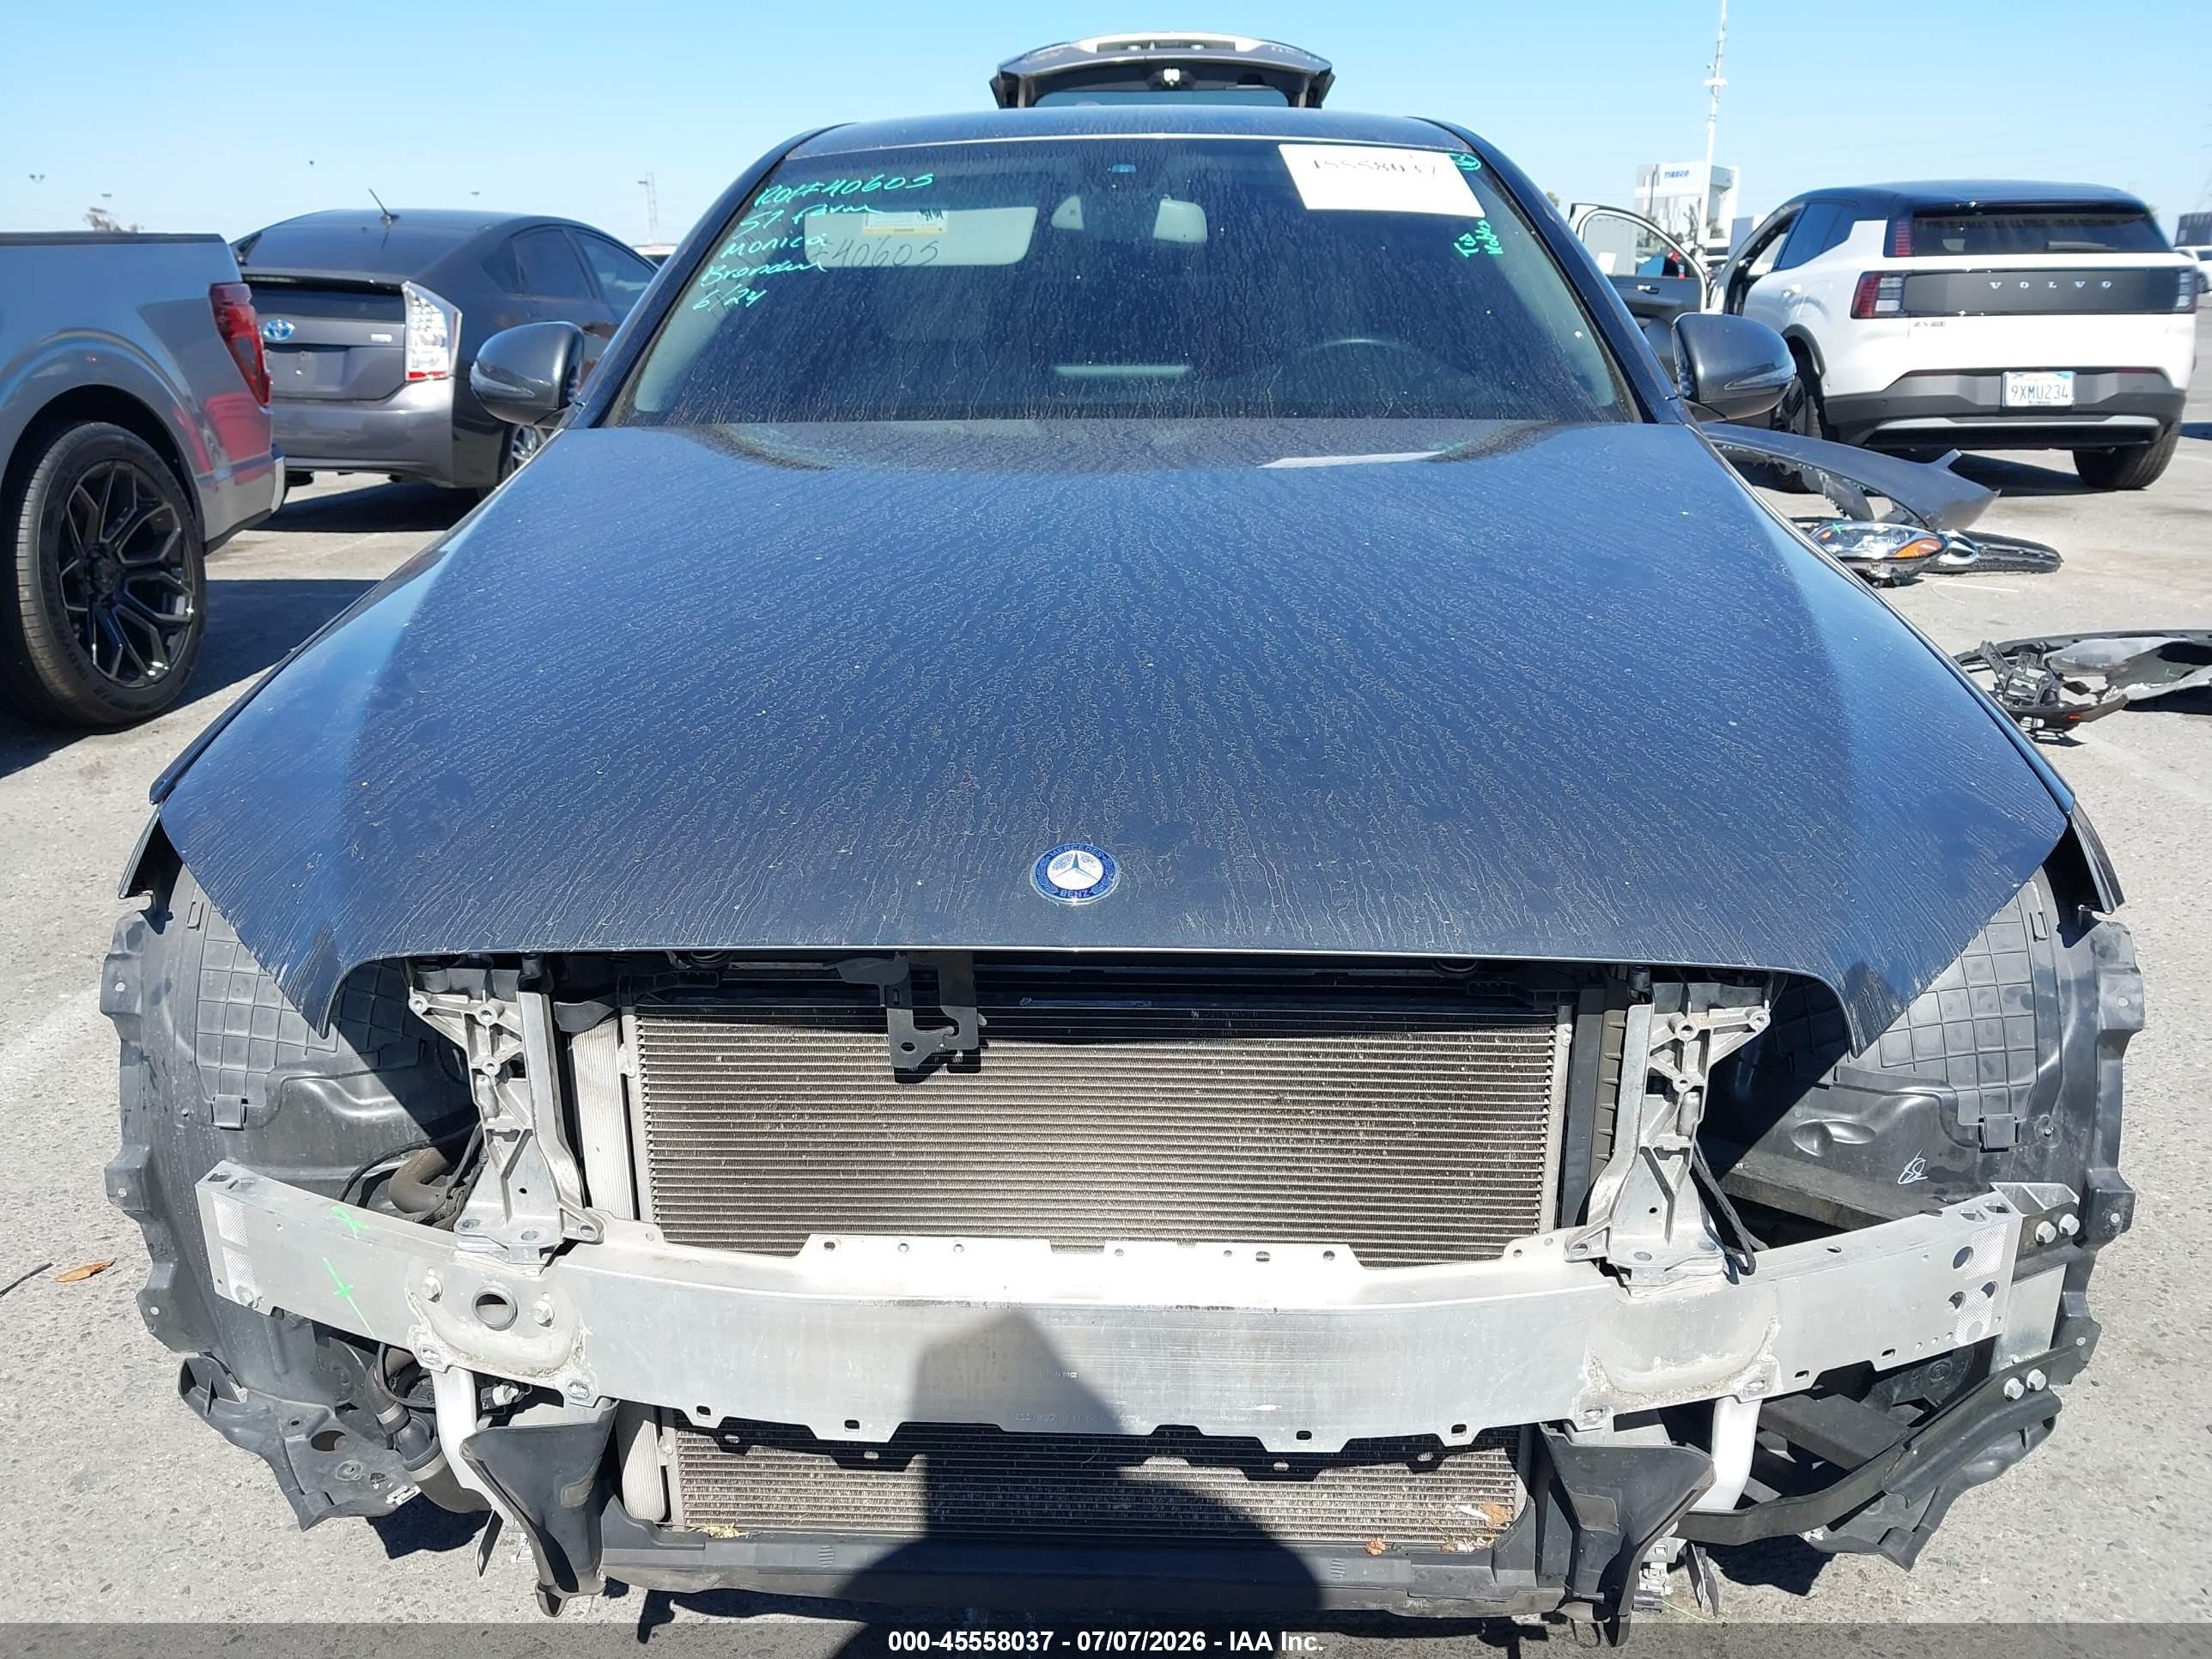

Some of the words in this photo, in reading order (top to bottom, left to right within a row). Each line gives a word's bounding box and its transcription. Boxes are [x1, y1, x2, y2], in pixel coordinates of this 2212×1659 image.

[1989, 280, 2112, 289] VOLVO
[2011, 384, 2069, 401] 9XMU234
[1059, 890, 1091, 899] BENZ
